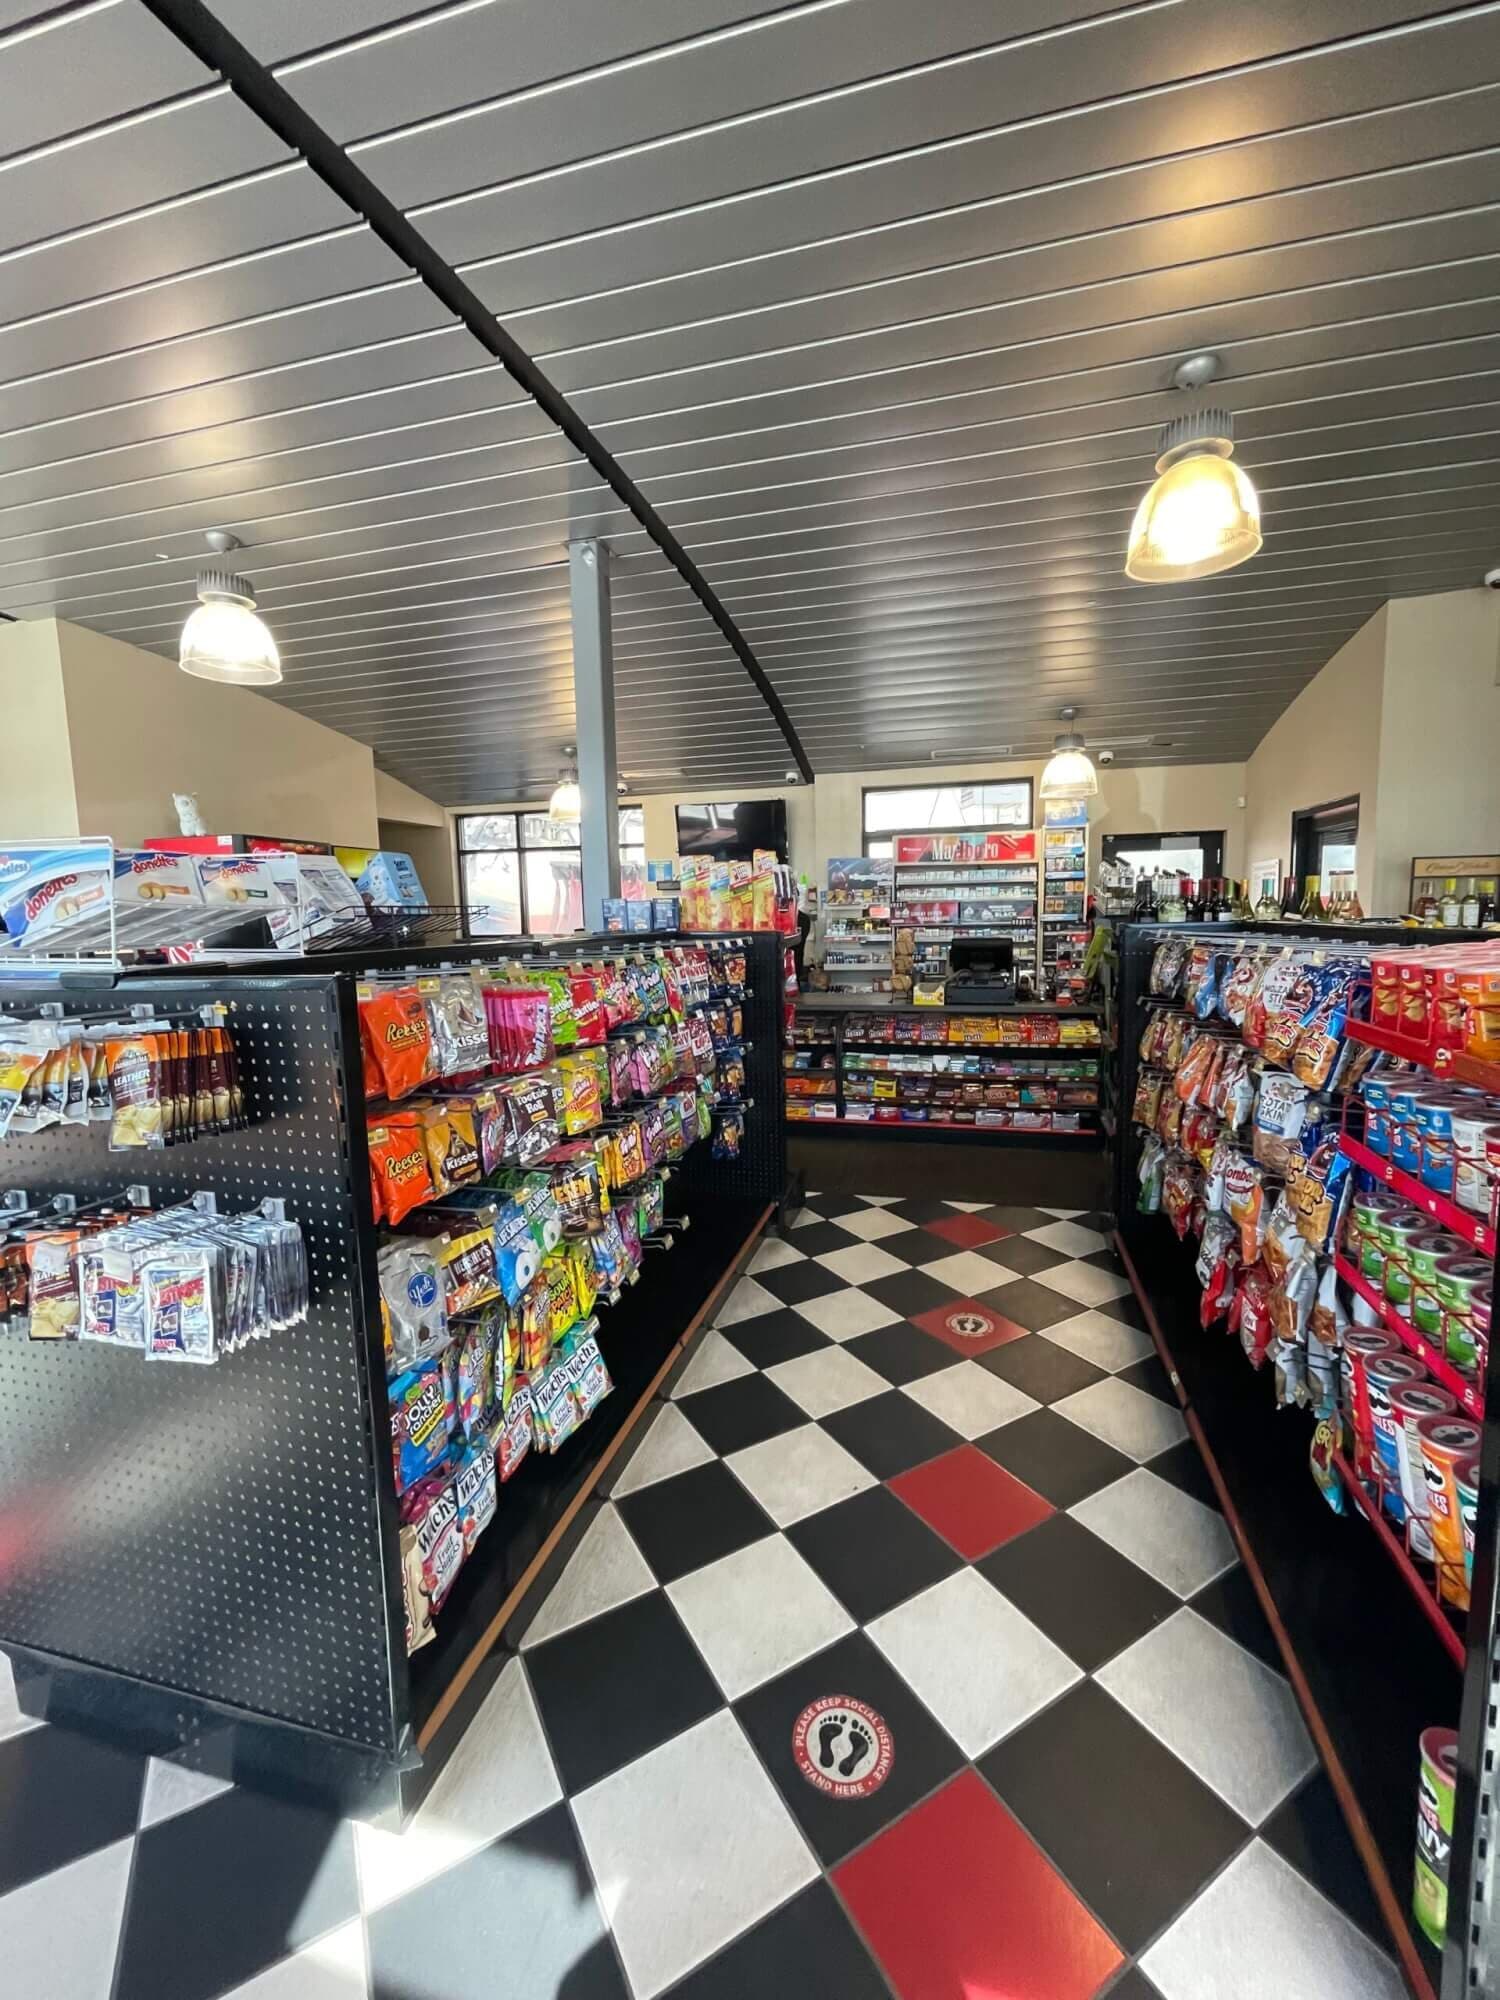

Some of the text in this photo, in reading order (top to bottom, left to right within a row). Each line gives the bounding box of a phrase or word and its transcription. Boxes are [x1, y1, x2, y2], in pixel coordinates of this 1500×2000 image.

[932, 837, 999, 861] Marlboro
[132, 856, 177, 874] donettes
[452, 1032, 489, 1049] KISSE
[404, 1384, 435, 1430] JOLLY
[795, 1698, 892, 1781] PLEASE KEEP SOCIAL DISTANCE
[801, 1760, 865, 1795] STAND HERE
